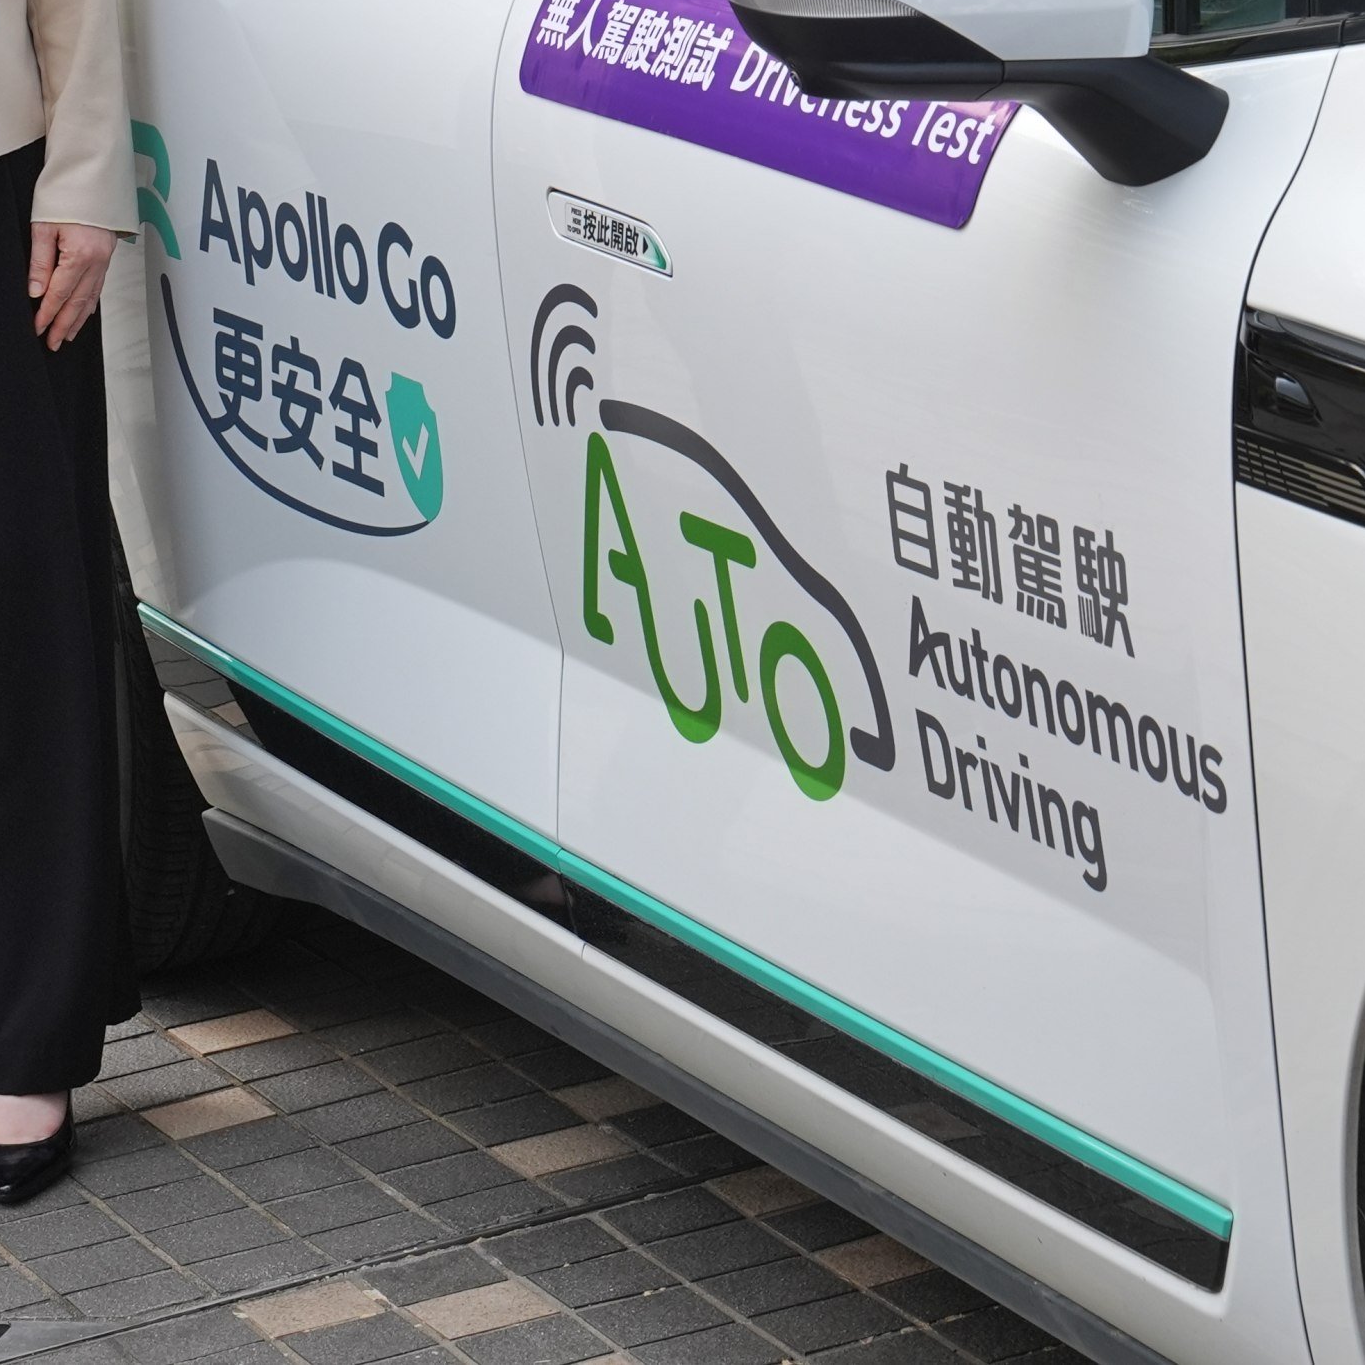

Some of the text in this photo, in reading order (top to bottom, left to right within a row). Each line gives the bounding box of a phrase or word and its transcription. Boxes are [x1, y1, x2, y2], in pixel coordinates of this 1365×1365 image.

[911, 100, 996, 165] Test
[199, 158, 457, 340] Apollo Go
[583, 209, 639, 256] 按此開啟
[212, 306, 386, 498] 更安全
[583, 432, 846, 802] AUTO
[885, 462, 1135, 658] 自動駕駛
[908, 595, 1228, 814] Autonomous
[915, 708, 1108, 893] Driving
